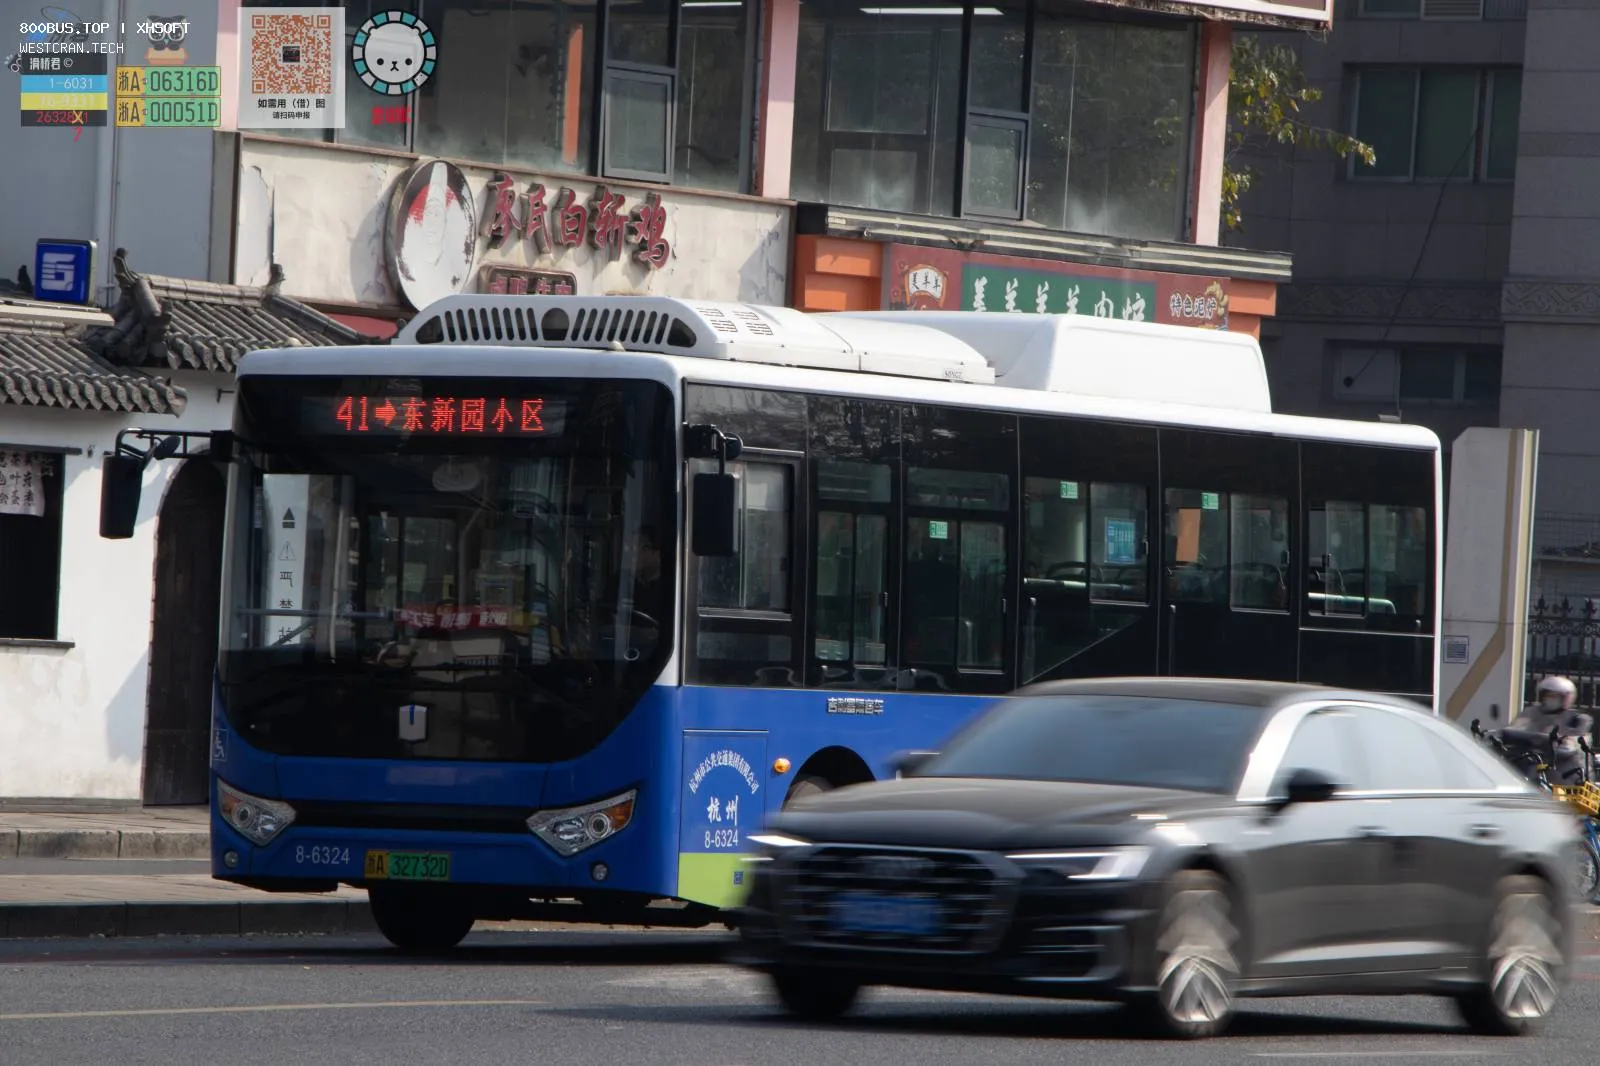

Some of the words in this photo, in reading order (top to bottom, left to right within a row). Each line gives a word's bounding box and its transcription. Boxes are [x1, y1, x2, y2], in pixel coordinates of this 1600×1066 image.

[336, 396, 369, 431] 41
[402, 396, 544, 432] 东新园小区
[707, 795, 739, 826] 杭州
[704, 829, 739, 848] 8-6324
[295, 845, 350, 865] 8-6324
